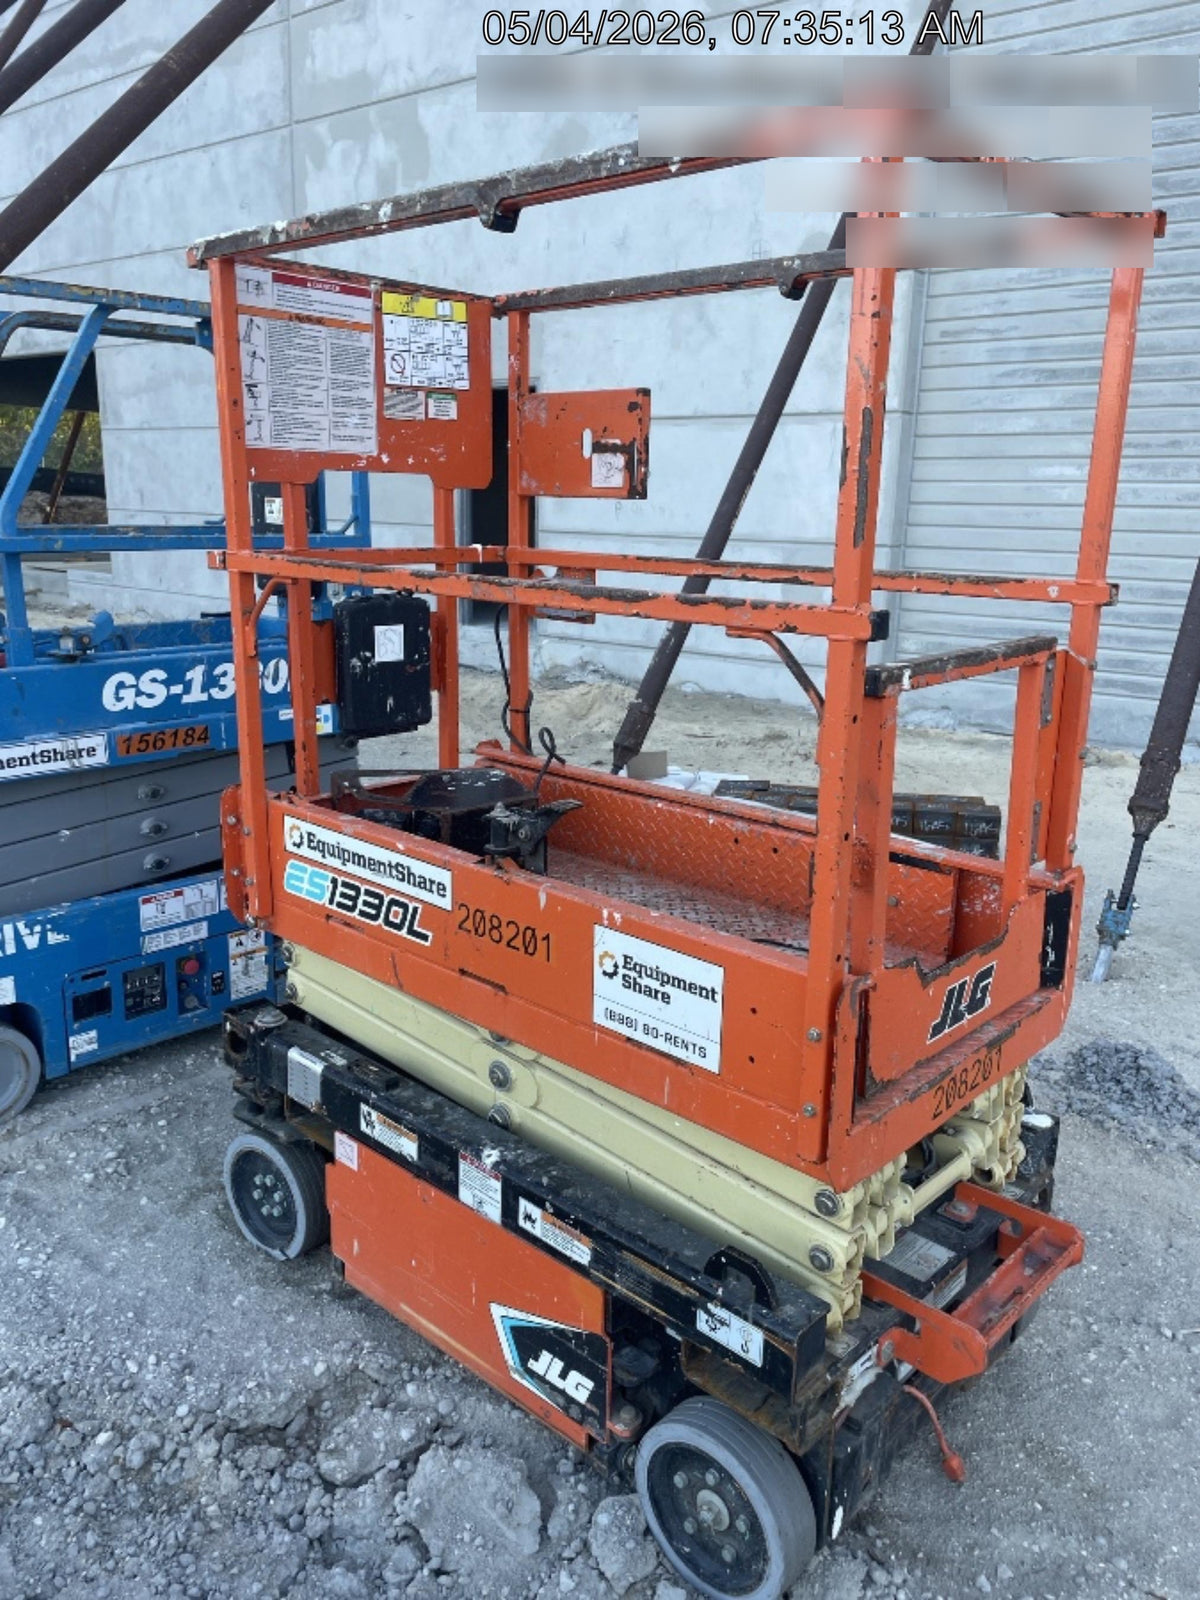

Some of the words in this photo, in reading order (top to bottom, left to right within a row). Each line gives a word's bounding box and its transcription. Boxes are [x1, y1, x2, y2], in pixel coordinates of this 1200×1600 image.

[120, 725, 210, 755] 156184
[306, 830, 448, 899] EquipmentShare
[284, 859, 433, 946] ES1330L
[457, 903, 552, 963] 208201
[621, 954, 719, 1004] Equipment
[621, 973, 672, 1006] Share
[927, 960, 997, 1044] JLG
[642, 1023, 707, 1059] 80-RENTS
[931, 1048, 1003, 1121] 208201
[527, 1349, 595, 1405] JLG
